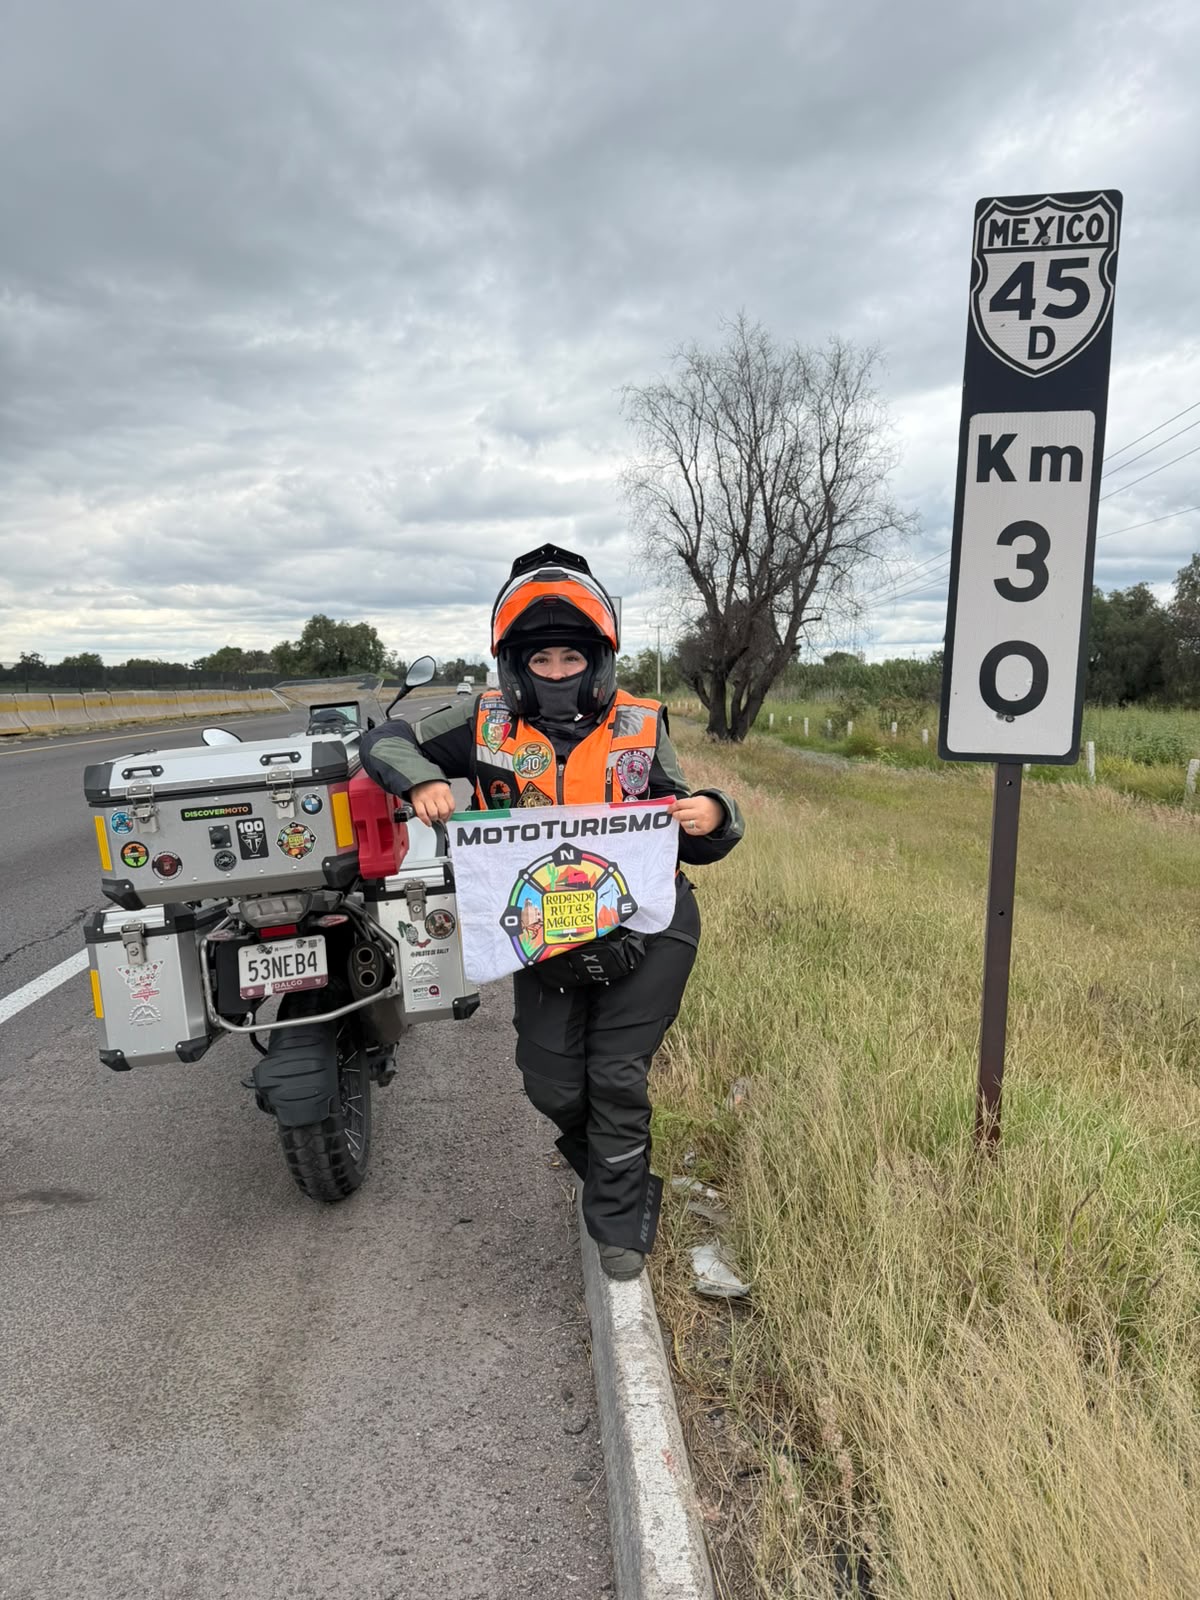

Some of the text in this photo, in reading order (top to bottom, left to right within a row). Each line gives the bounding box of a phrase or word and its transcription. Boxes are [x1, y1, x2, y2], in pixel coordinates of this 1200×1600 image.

[988, 213, 1104, 247] MEXICO
[989, 257, 1090, 320] 45
[1027, 325, 1056, 360] D
[976, 433, 1083, 483] Km
[993, 519, 1051, 603] 3
[979, 640, 1049, 717] 0
[527, 756, 540, 770] 10
[184, 806, 249, 818] DISCOVERMOTO
[238, 820, 264, 834] 100
[457, 811, 673, 847] MOTOTURISMO
[559, 849, 575, 860] N
[621, 902, 633, 913] E
[248, 951, 318, 982] 53NEB4
[272, 979, 303, 989] DALGO
